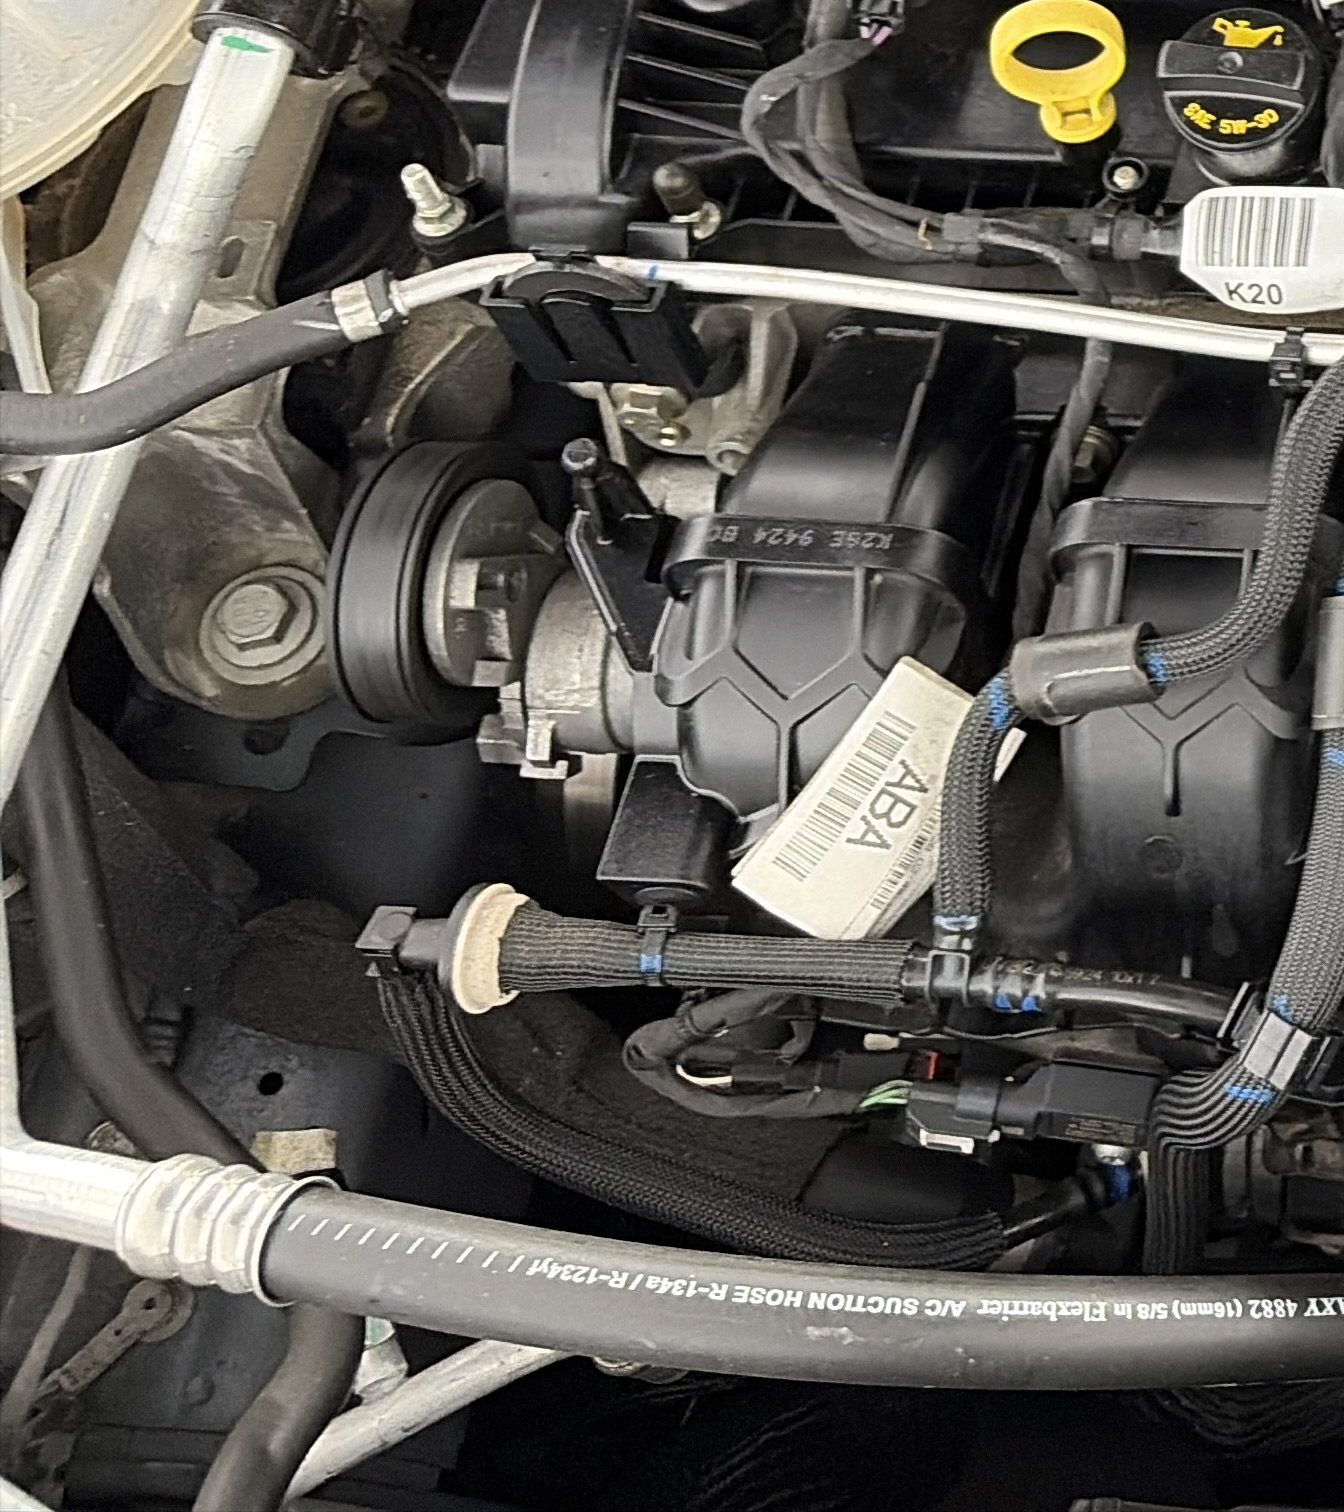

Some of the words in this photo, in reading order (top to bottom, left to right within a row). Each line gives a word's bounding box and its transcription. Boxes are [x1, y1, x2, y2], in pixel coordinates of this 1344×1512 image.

[1183, 102, 1217, 130] SAE
[1218, 108, 1280, 135] 5W-30
[1224, 281, 1284, 305] K20
[750, 527, 816, 548] 9424
[846, 758, 929, 852] ABA
[528, 1258, 630, 1289] R-1234yf
[645, 1274, 729, 1302] R-134a
[731, 1284, 803, 1308] HOSE
[808, 1292, 919, 1317] SUCTION
[917, 1298, 966, 1318] A/C
[978, 1297, 1108, 1323] Flexbarrier
[1136, 1301, 1169, 1321] 5/8
[1171, 1299, 1244, 1322] (16mm)
[1247, 1296, 1298, 1320] 4882
